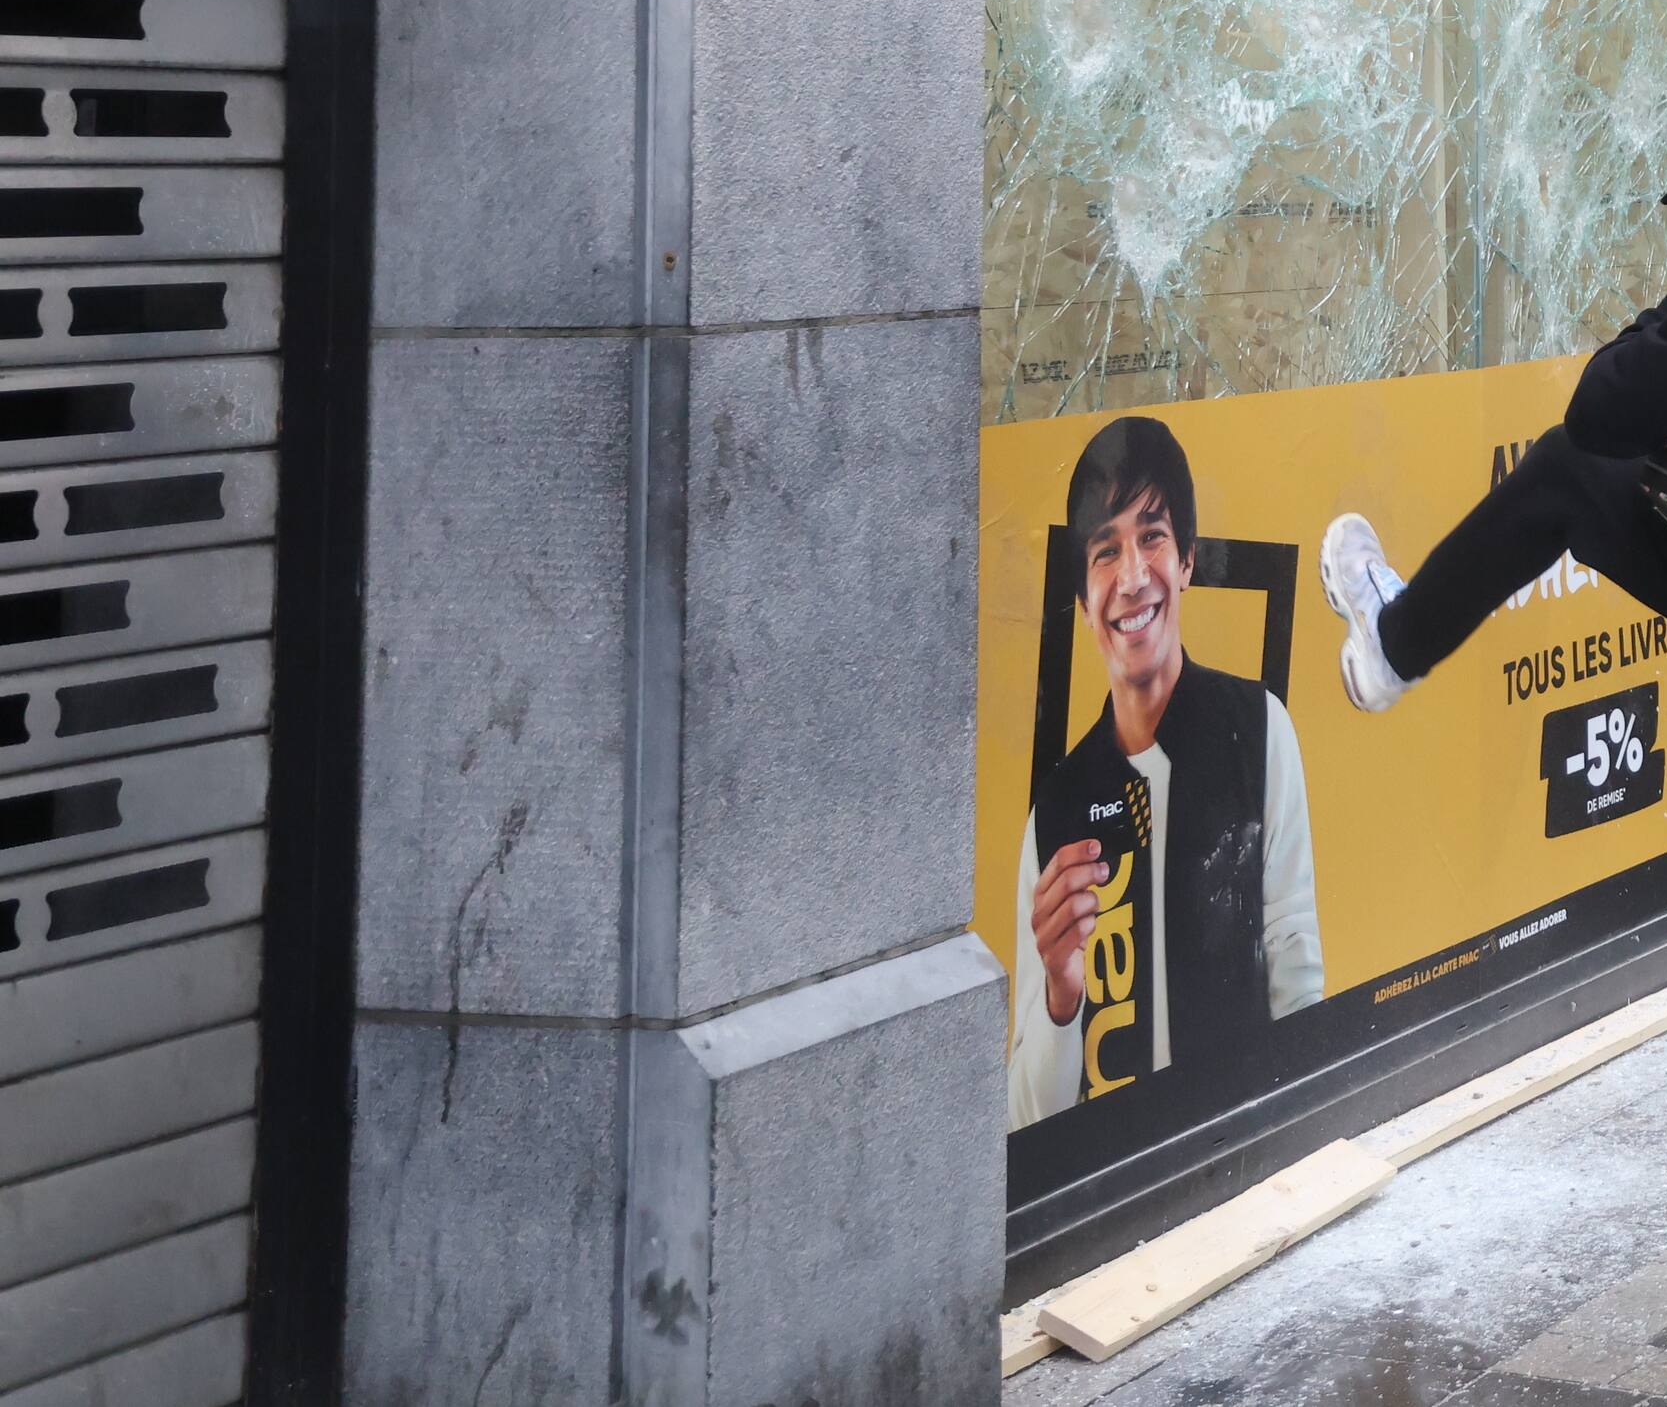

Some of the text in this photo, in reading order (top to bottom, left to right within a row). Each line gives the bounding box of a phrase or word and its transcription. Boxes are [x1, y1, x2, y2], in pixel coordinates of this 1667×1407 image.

[1503, 645, 1566, 706] TOUS
[1573, 631, 1612, 682] LES
[1566, 707, 1644, 787] -5%
[1089, 798, 1125, 822] fnac
[1586, 799, 1598, 814] DE
[1373, 976, 1413, 1005] ADHÉREZ
[1420, 969, 1432, 985] LA
[1431, 958, 1458, 979] CARTE
[1458, 948, 1480, 969] FNAC
[1499, 930, 1519, 951] VOUS
[1519, 920, 1540, 942] ALLEZ
[1539, 908, 1567, 931] ADORER
